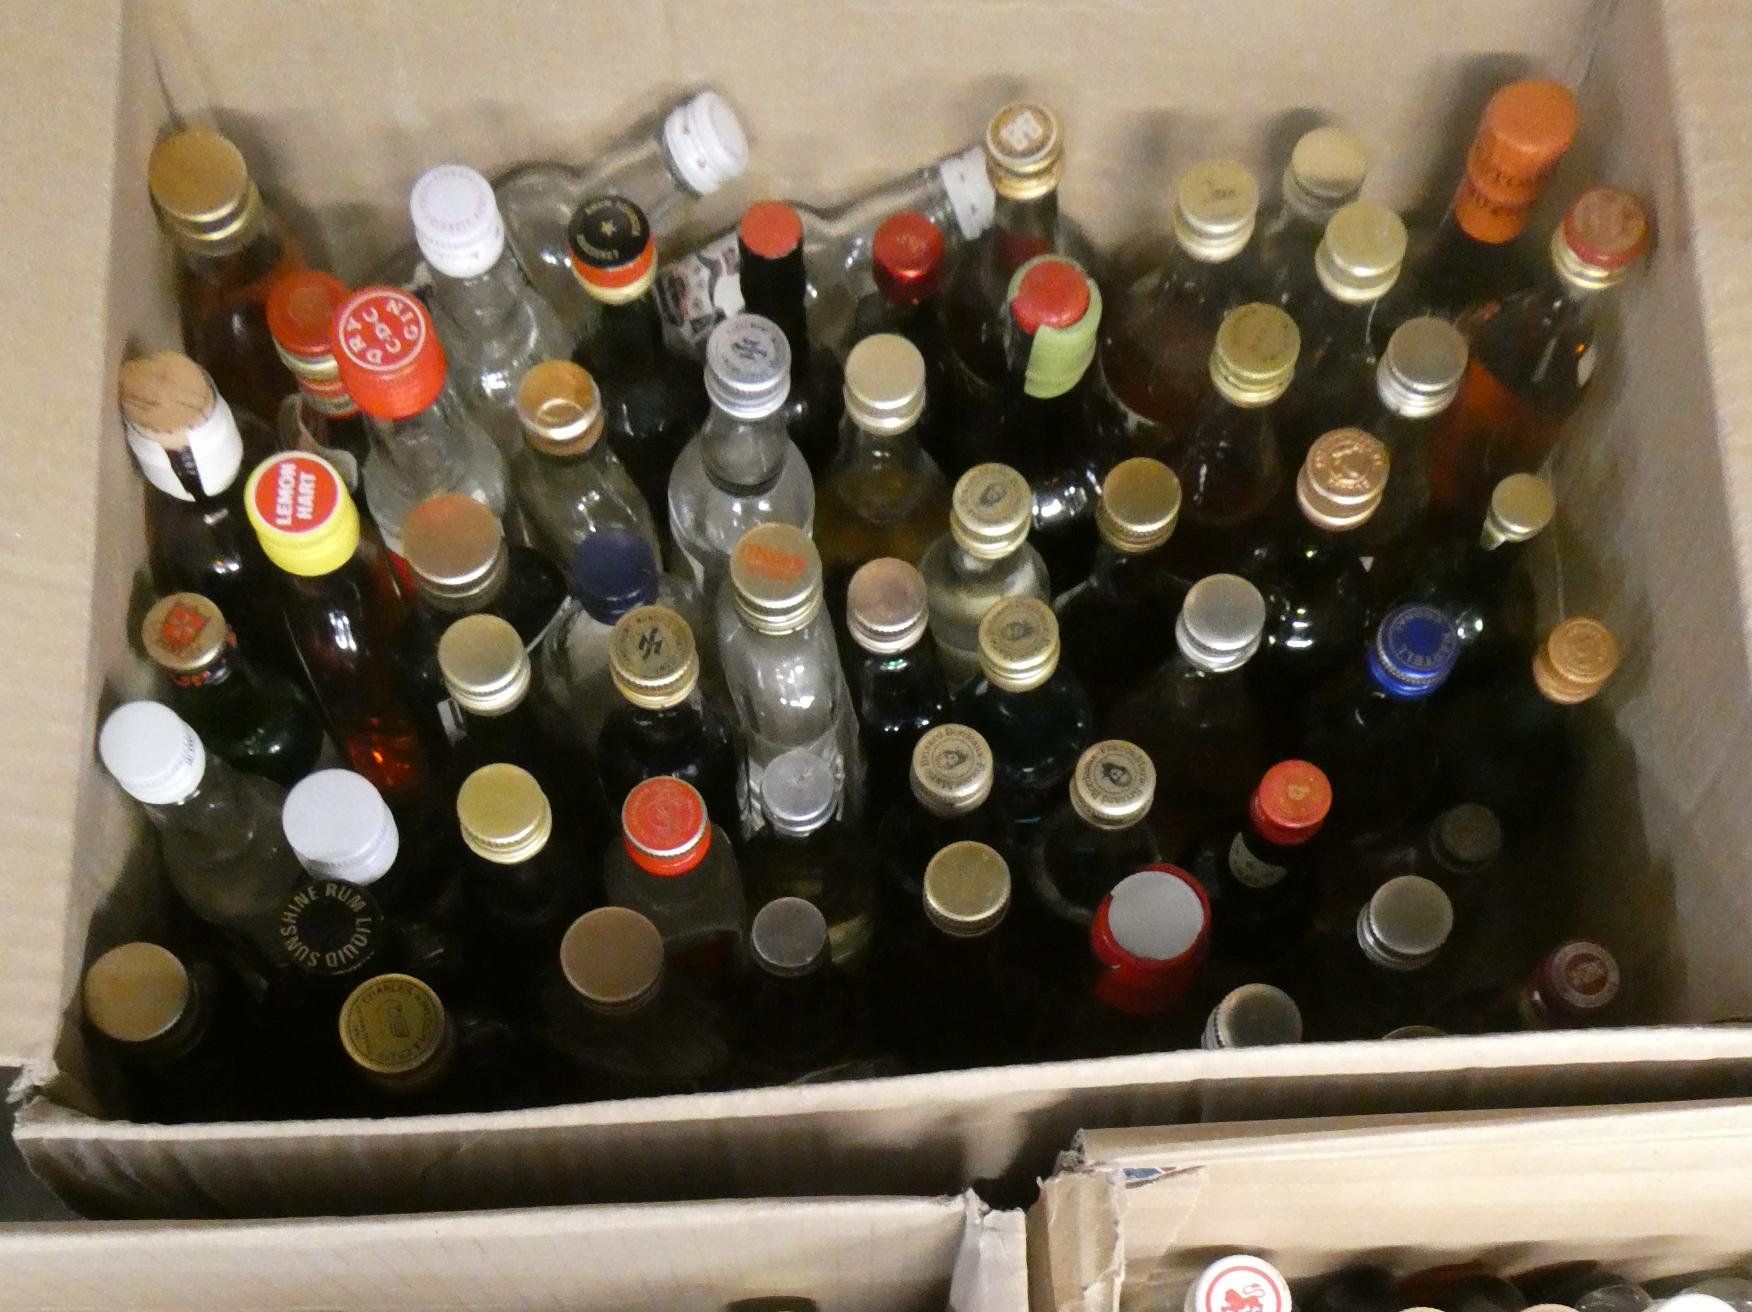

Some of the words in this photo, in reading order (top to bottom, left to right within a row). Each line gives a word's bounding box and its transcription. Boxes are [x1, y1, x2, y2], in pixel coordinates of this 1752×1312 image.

[346, 316, 384, 364] DRY
[386, 299, 419, 341] GIN
[276, 463, 297, 526] LEMON
[297, 471, 317, 520] HART
[325, 882, 368, 912] RUM
[280, 885, 321, 968] SUNSHINE
[325, 917, 372, 968] LIQUID
